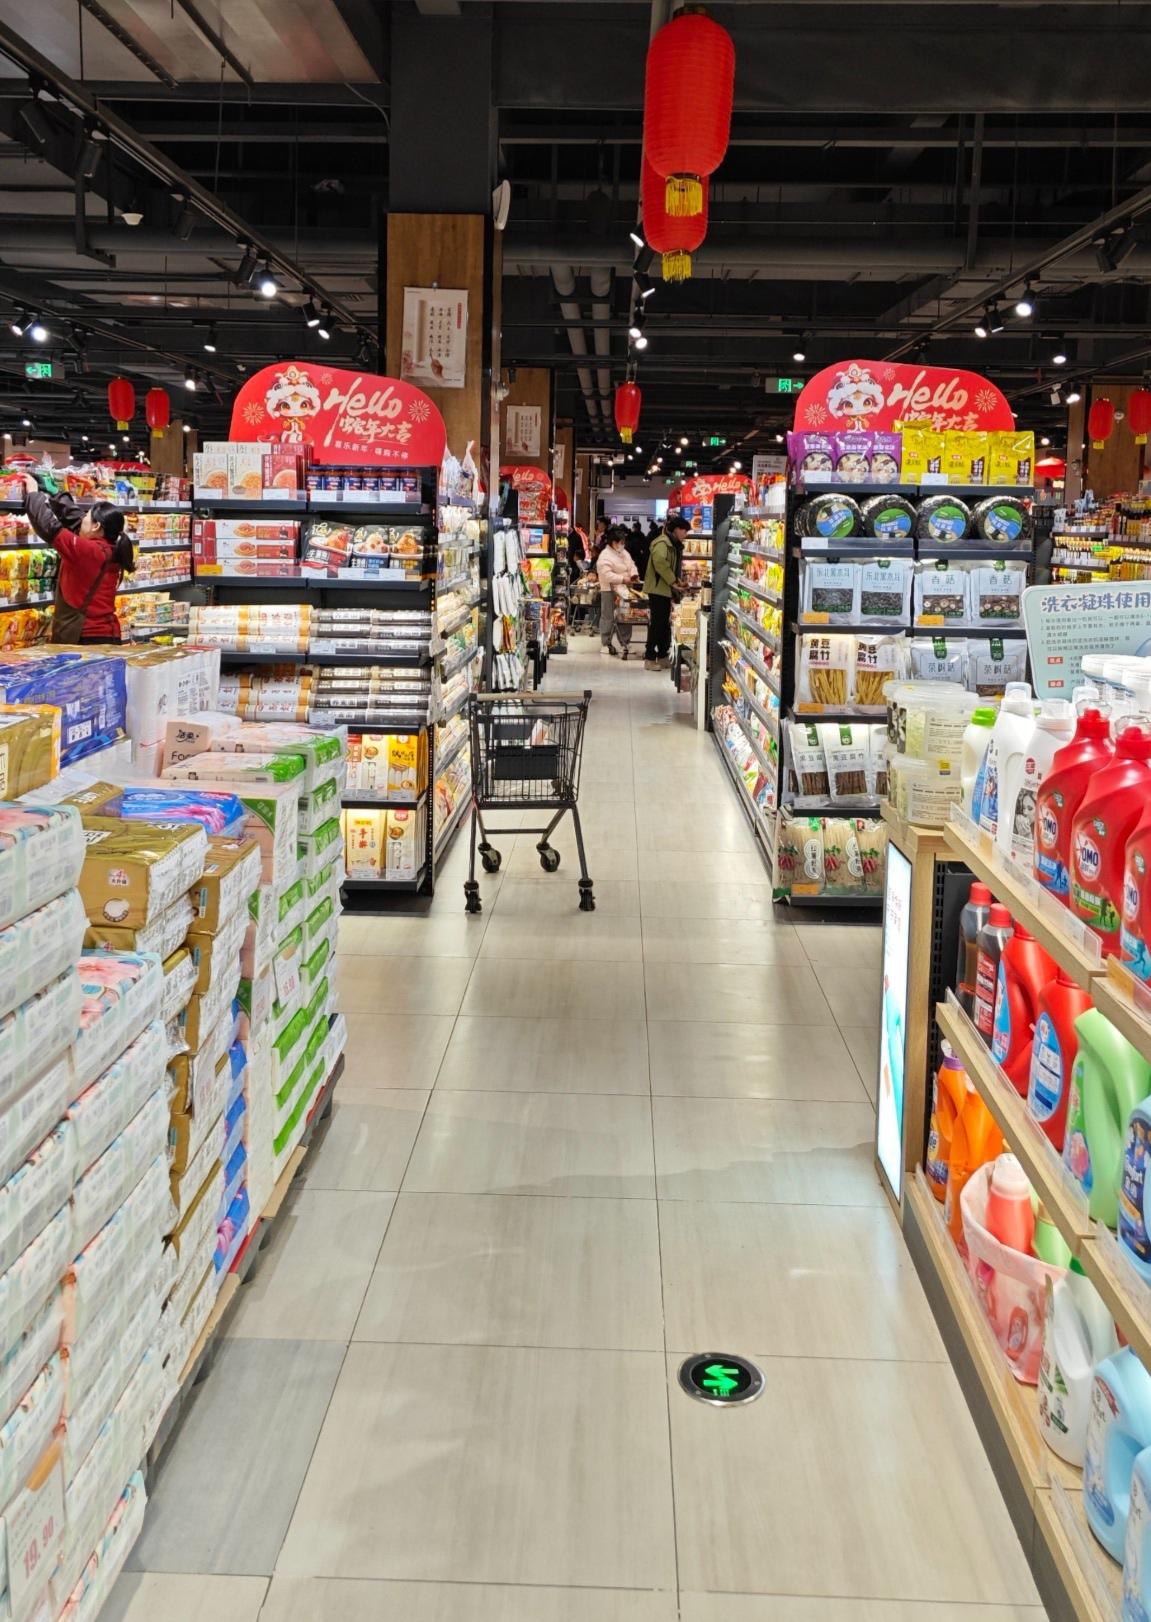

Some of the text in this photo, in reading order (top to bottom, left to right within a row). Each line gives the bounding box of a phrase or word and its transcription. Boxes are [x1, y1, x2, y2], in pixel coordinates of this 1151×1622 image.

[887, 370, 968, 412] Hello
[323, 377, 402, 432] Hello
[932, 574, 955, 585] 香菇
[990, 574, 1012, 585] 香菇
[1041, 592, 1151, 613] 洗衣凝珠使用
[928, 662, 955, 673] 茶树菇
[984, 664, 1011, 675] 茶树菇
[1081, 847, 1099, 867] OMO
